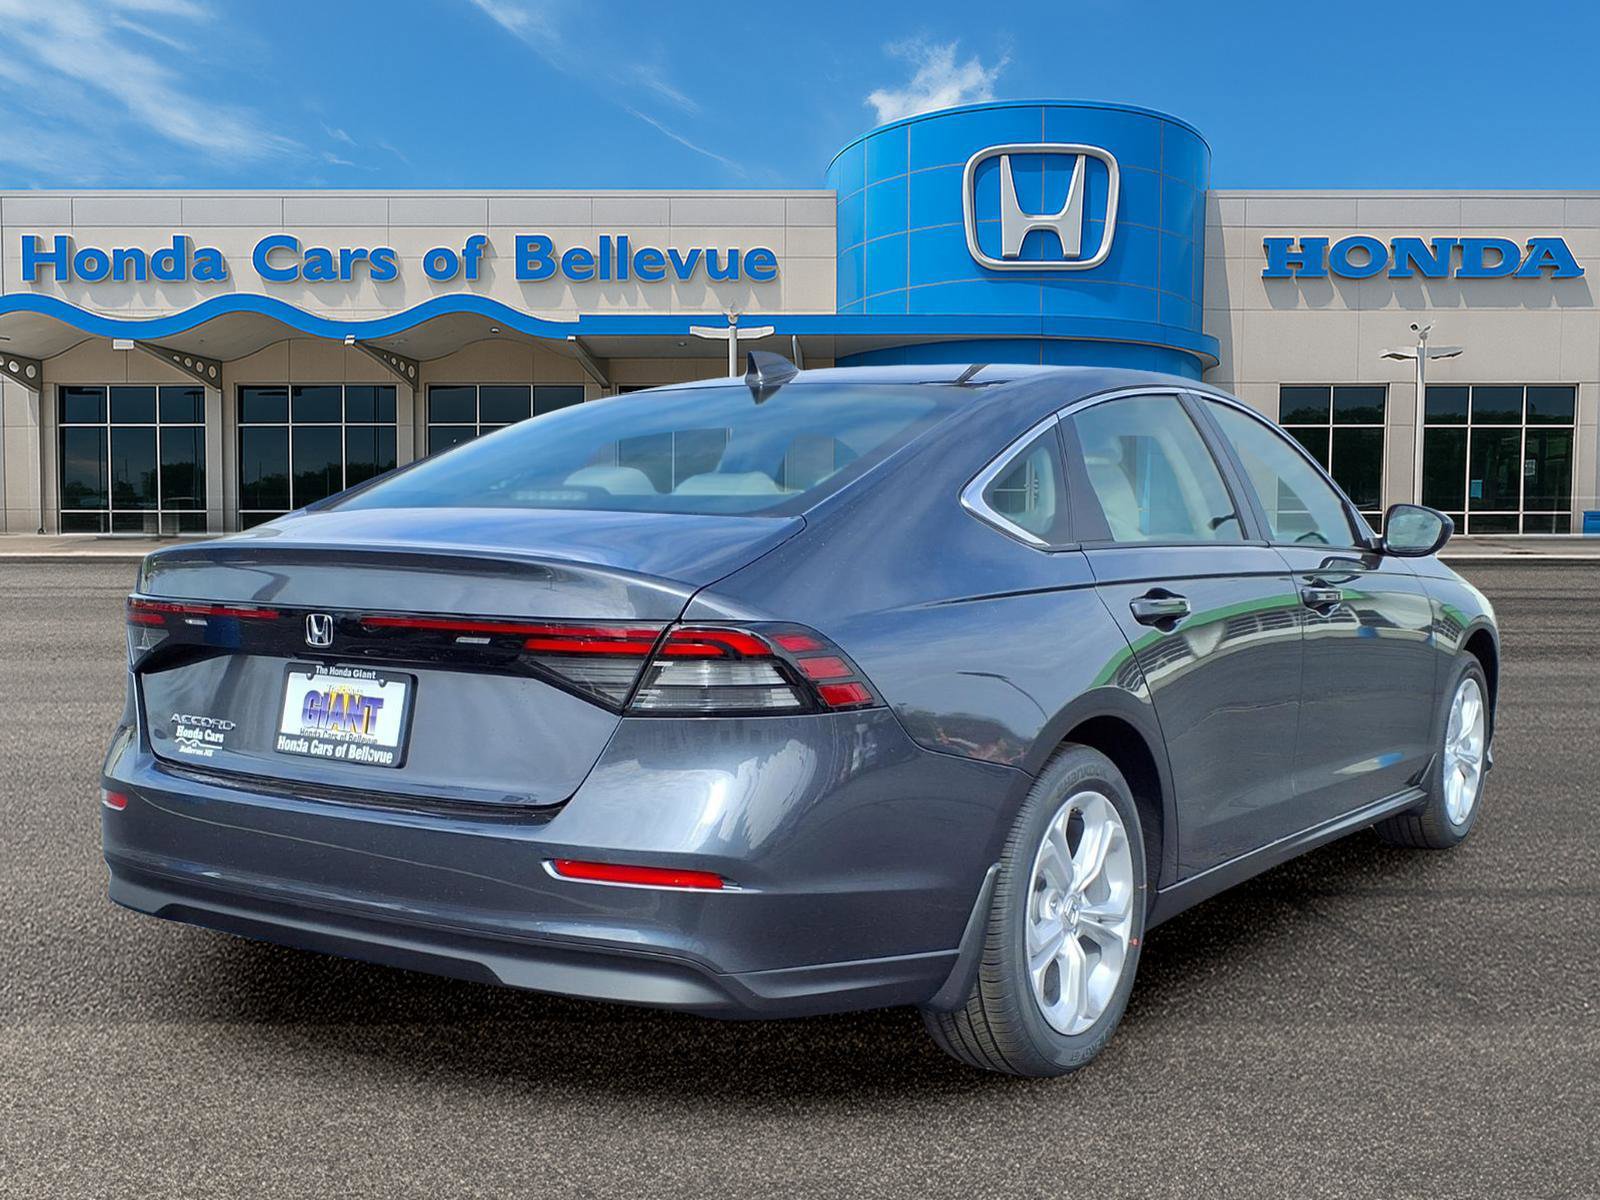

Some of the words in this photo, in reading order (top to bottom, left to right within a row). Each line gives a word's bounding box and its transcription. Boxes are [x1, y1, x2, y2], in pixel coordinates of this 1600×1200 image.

[20, 234, 229, 283] Honda
[252, 234, 400, 282] Cars
[422, 234, 488, 281] of
[514, 234, 780, 282] Bellevue
[1261, 235, 1586, 279] HONDA
[315, 665, 328, 675] The
[330, 666, 351, 677] Honda
[353, 669, 377, 680] Giant
[171, 713, 236, 730] ACCORD
[302, 690, 385, 735] GIANT
[176, 725, 203, 740] Honda
[204, 729, 224, 743] Cars
[277, 736, 309, 753] Honda
[310, 739, 334, 756] Cars
[335, 743, 348, 758] of
[348, 744, 393, 764] Bellevue
